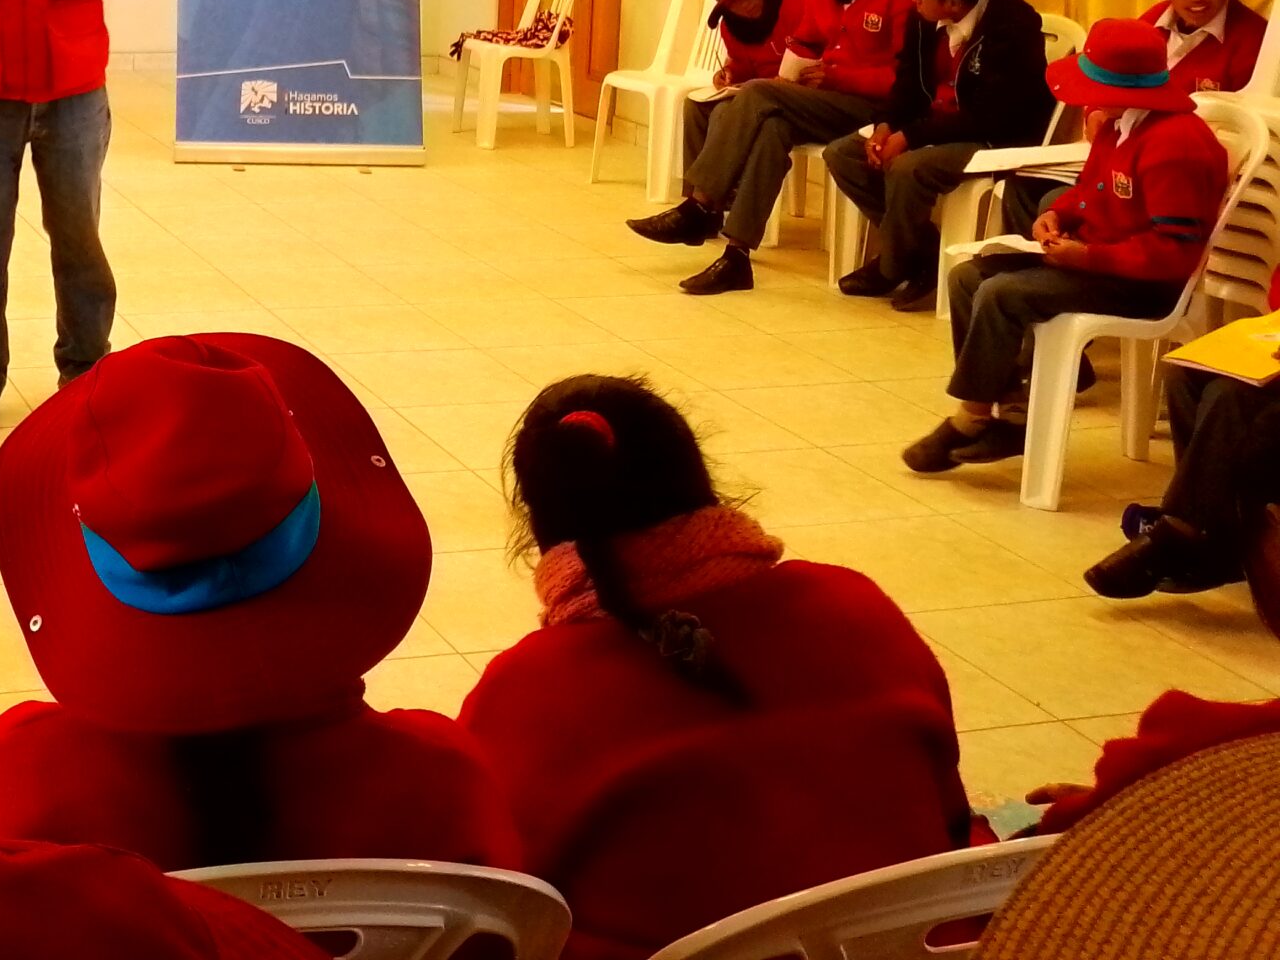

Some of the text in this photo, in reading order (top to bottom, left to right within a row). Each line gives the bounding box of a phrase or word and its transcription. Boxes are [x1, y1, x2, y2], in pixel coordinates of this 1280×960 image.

[289, 91, 338, 103] Hagamos
[289, 102, 359, 116] HISTORIA
[260, 879, 333, 900] REY
